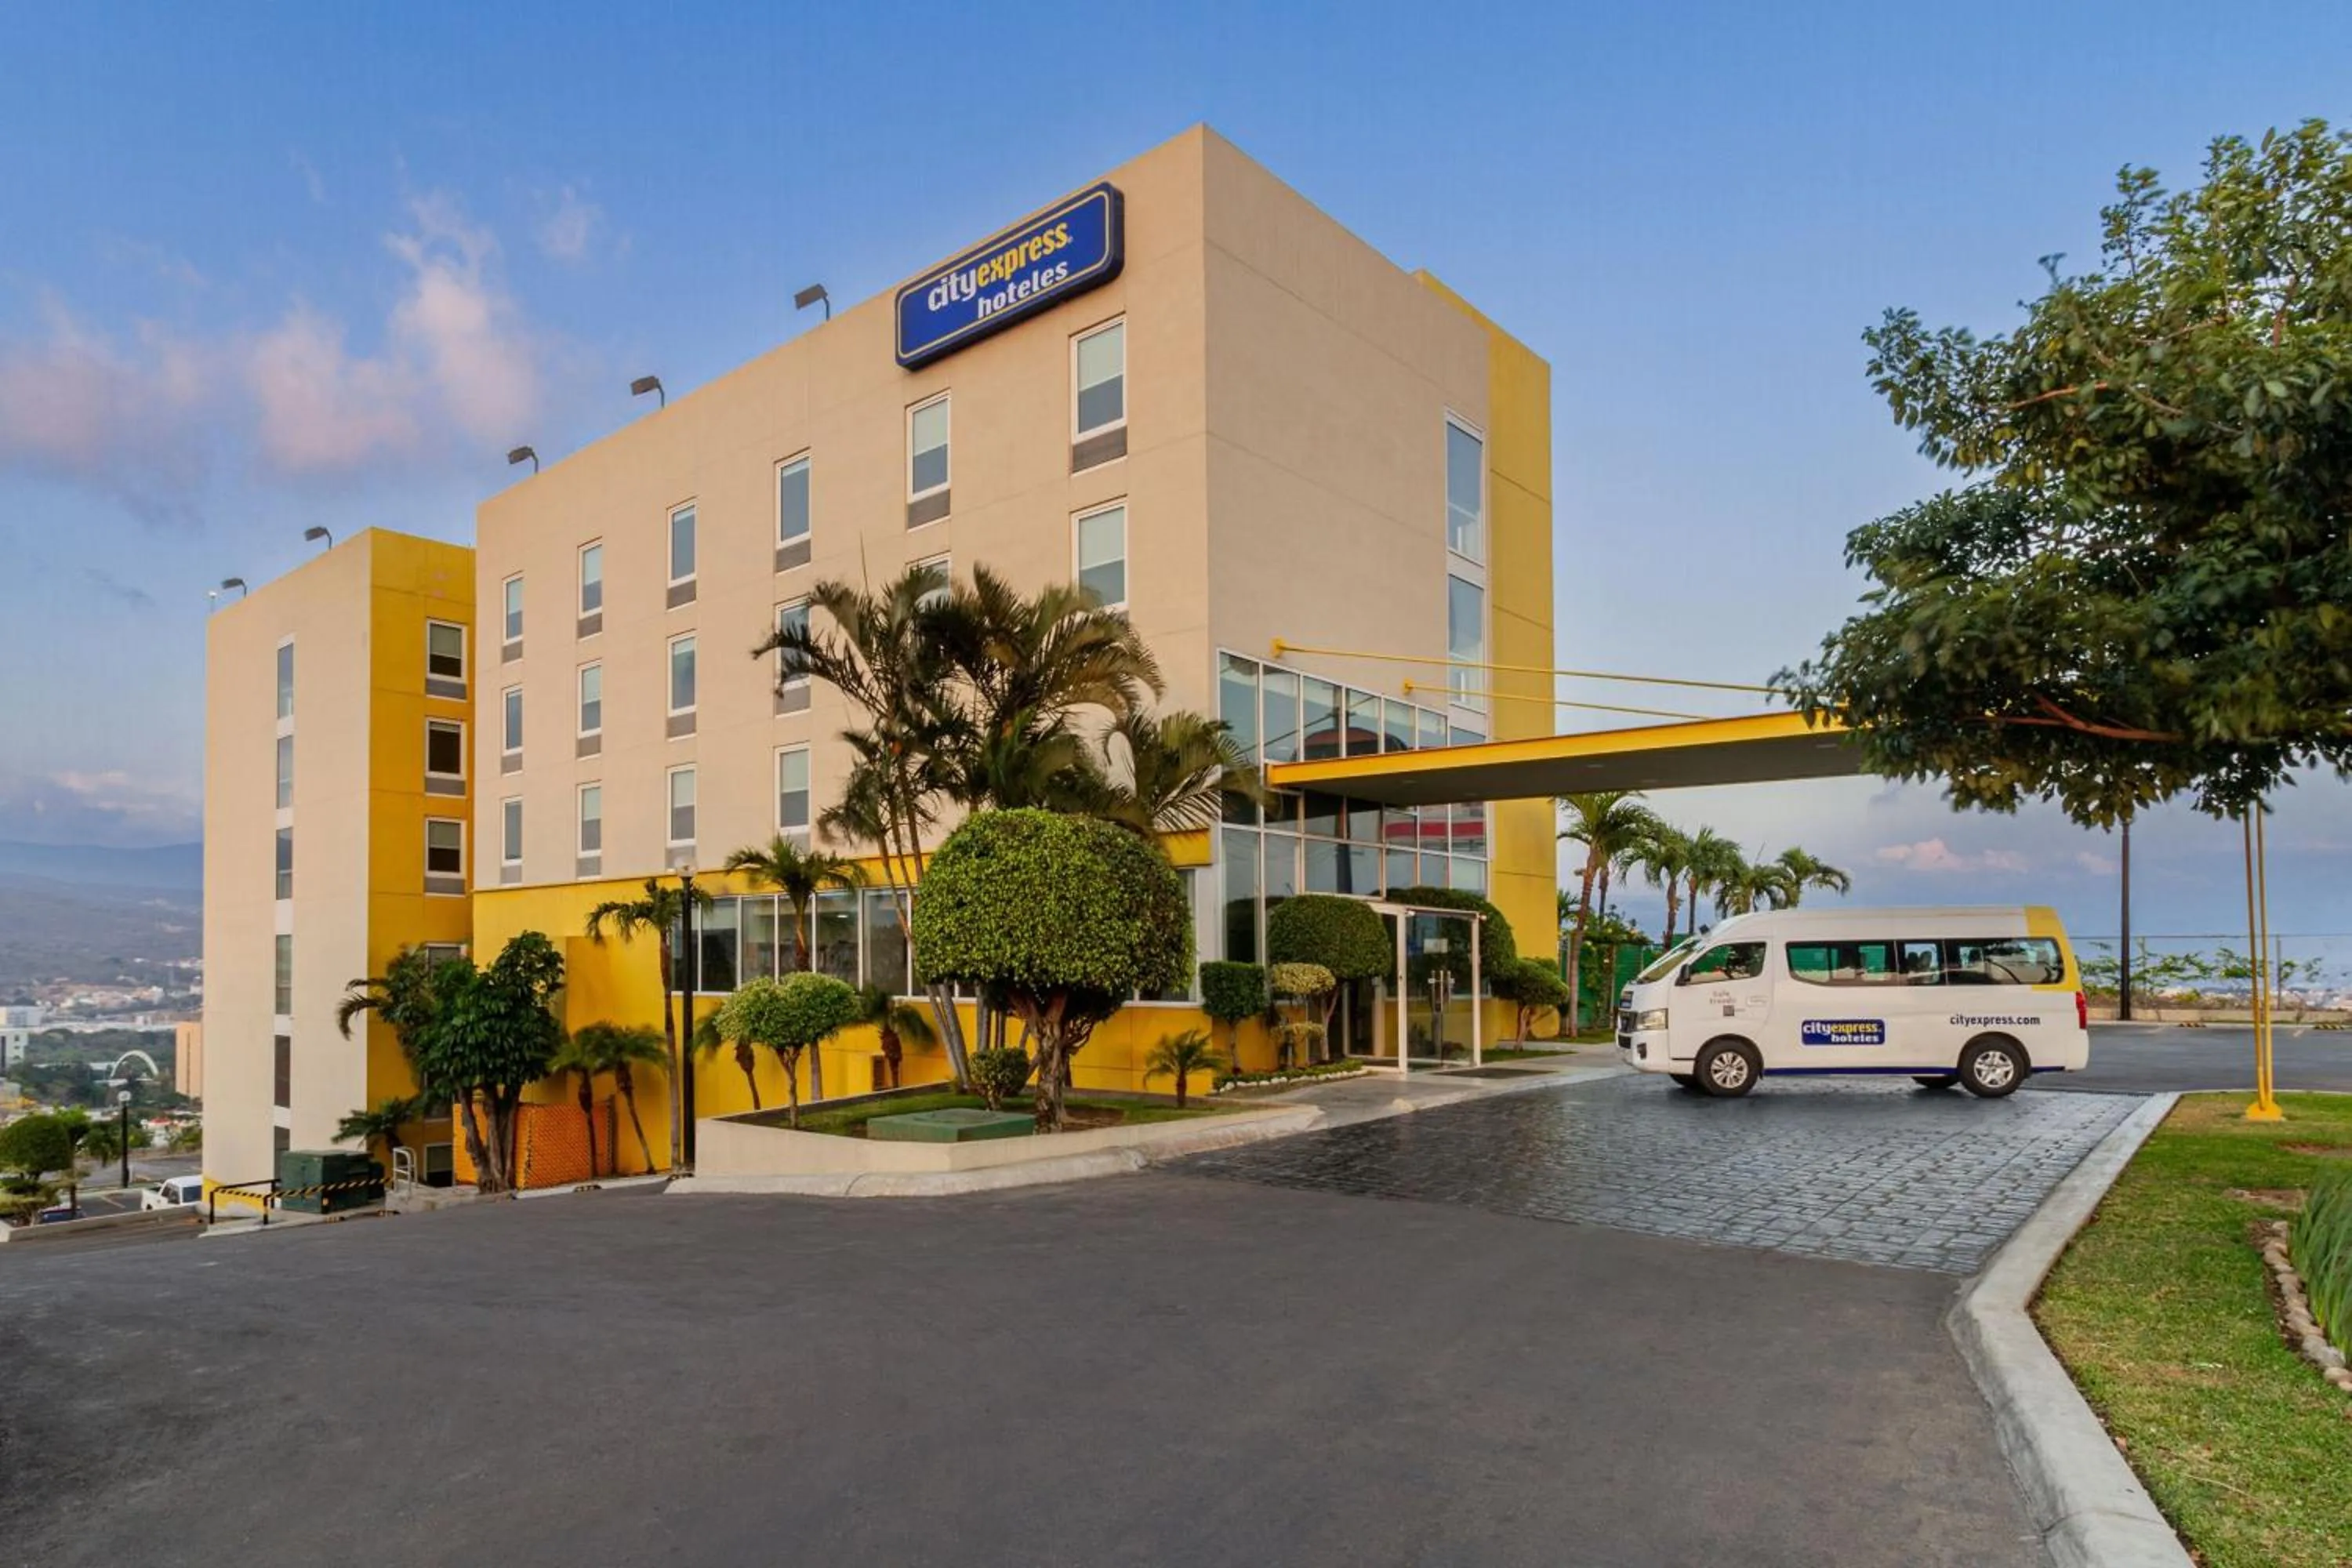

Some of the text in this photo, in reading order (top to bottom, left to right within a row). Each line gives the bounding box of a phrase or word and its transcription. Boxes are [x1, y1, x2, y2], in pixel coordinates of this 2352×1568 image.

[978, 261, 1069, 318] hoteles
[1950, 1014, 2041, 1027] cityexpress.com
[1831, 1033, 1879, 1043] hoteles
